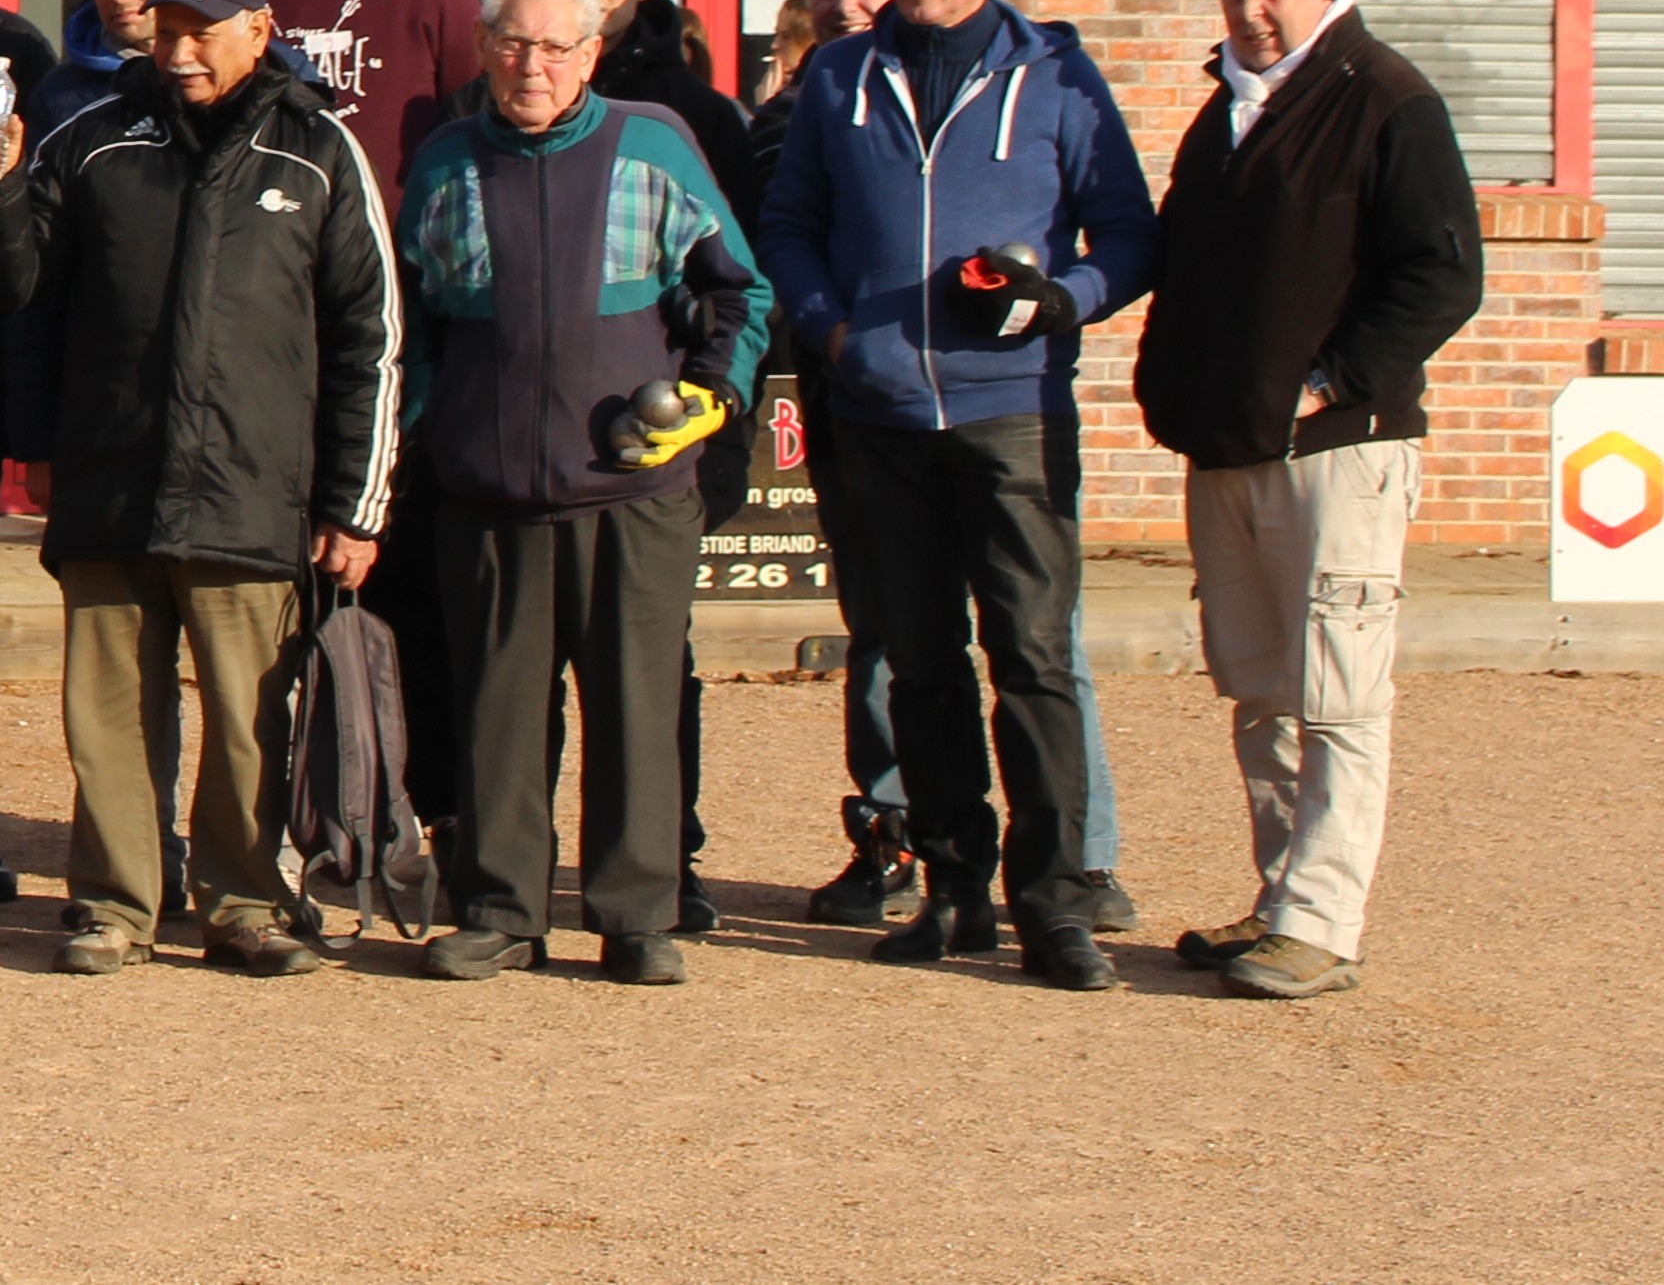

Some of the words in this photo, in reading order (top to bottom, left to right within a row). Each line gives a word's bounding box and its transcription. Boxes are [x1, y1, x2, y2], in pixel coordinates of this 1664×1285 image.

[767, 487, 818, 509] gros
[750, 535, 816, 554] BRIAND
[728, 563, 790, 589] 26
